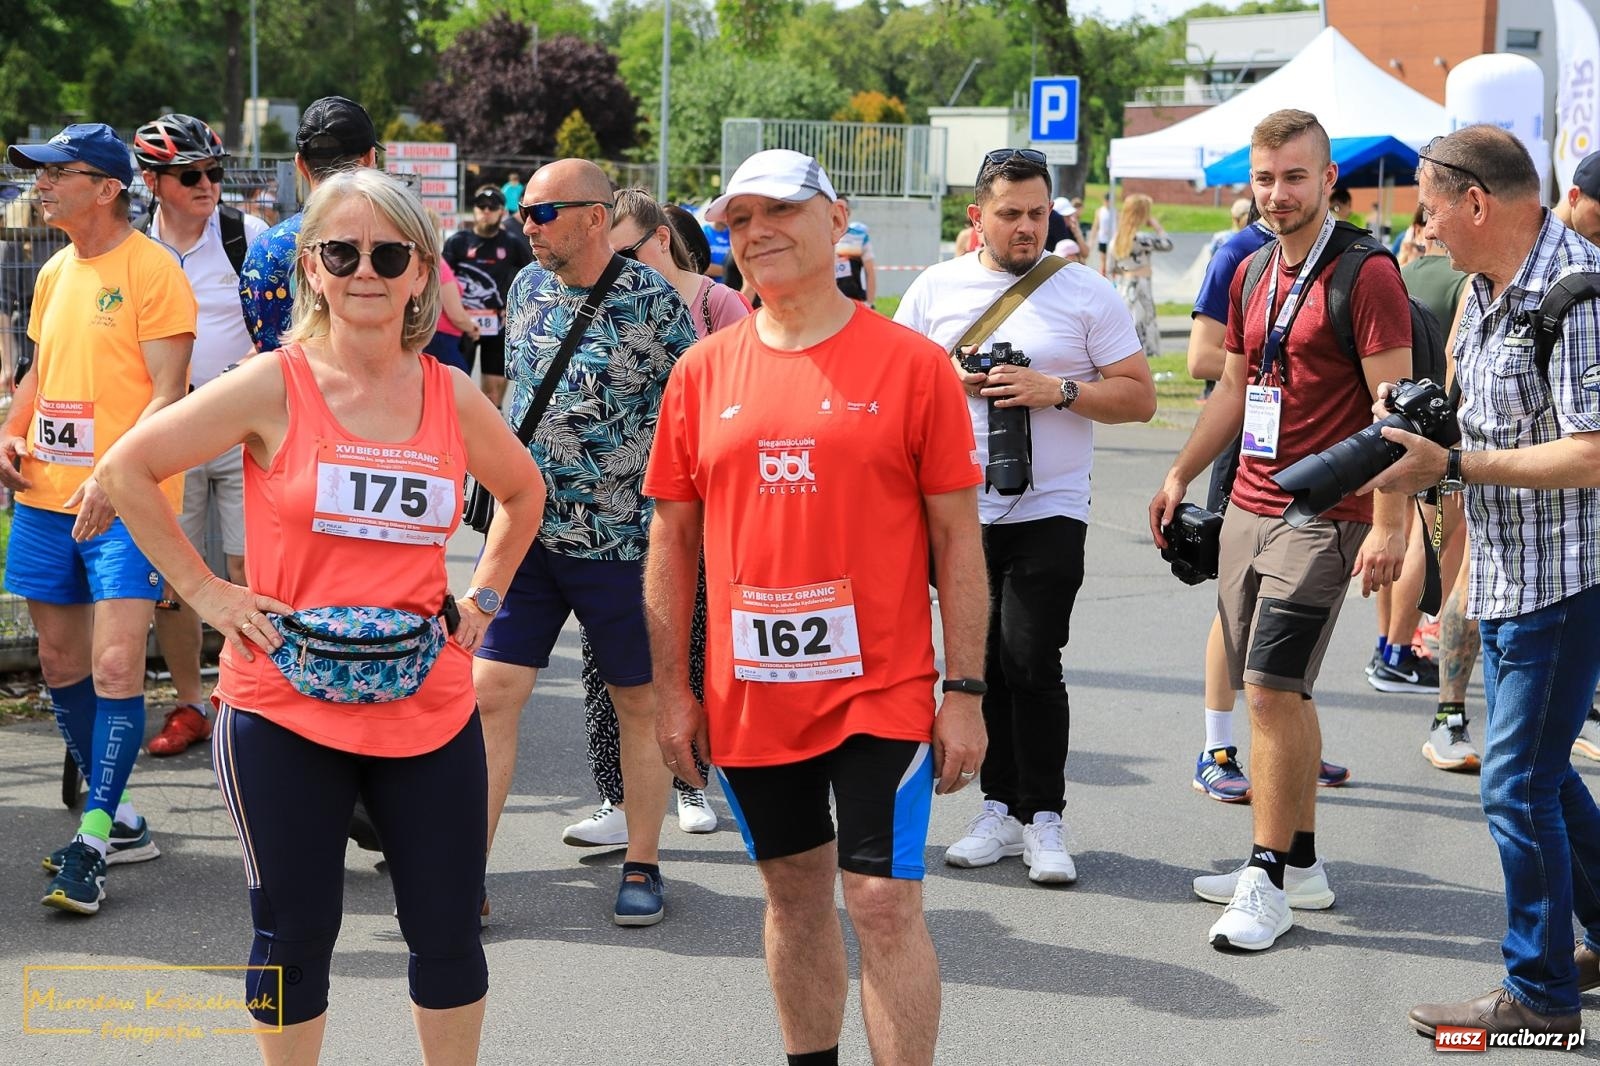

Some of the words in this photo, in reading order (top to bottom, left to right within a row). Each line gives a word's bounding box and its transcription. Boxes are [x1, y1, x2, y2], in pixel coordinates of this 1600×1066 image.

[1040, 85, 1068, 135] P
[56, 402, 83, 410] GRANIC
[39, 416, 78, 448] 154
[336, 444, 355, 454] XVI
[356, 446, 381, 457] BIEG
[382, 448, 402, 458] BEZ
[403, 450, 440, 464] GRANIC
[759, 450, 815, 482] bbl
[350, 472, 428, 518] 175
[760, 485, 817, 494] POLSKA
[742, 590, 754, 599] XVI
[756, 592, 774, 601] BIEG
[775, 593, 794, 602] BEZ
[795, 587, 836, 600] GRANIC
[752, 616, 831, 657] 162
